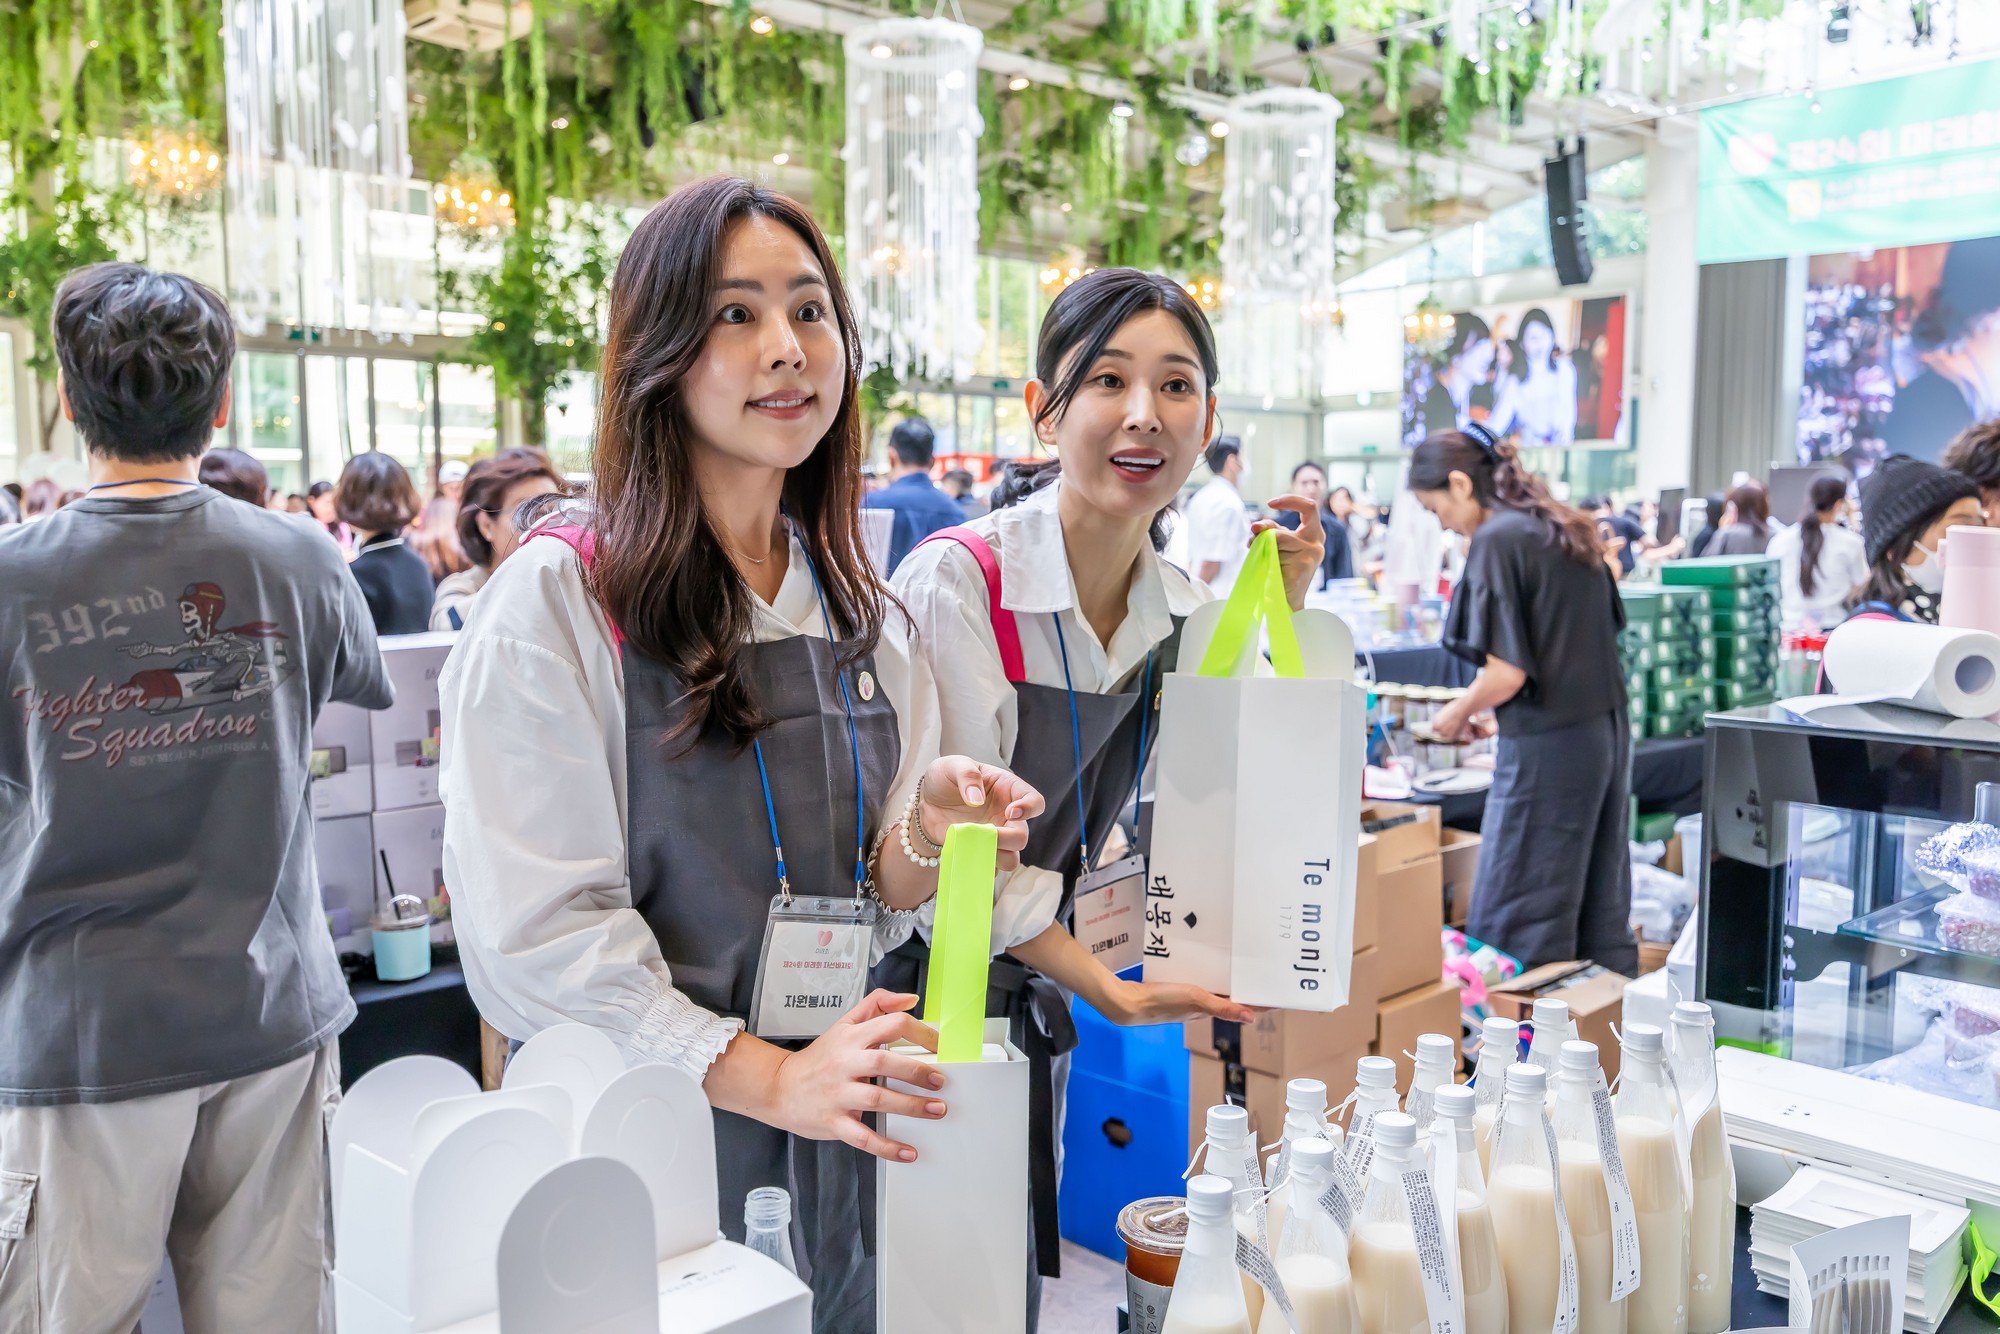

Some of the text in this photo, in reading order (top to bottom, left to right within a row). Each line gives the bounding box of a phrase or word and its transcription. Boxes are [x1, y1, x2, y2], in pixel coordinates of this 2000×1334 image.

[27, 586, 166, 653] 392nd
[13, 675, 148, 731] Fighter
[61, 707, 257, 768] Squadron
[1091, 932, 1129, 955] 자원봉사자
[1144, 874, 1175, 959] 대몽재
[1279, 905, 1292, 939] 1779
[1293, 858, 1331, 991] Te monje
[784, 994, 843, 1009] 자원봉사자
